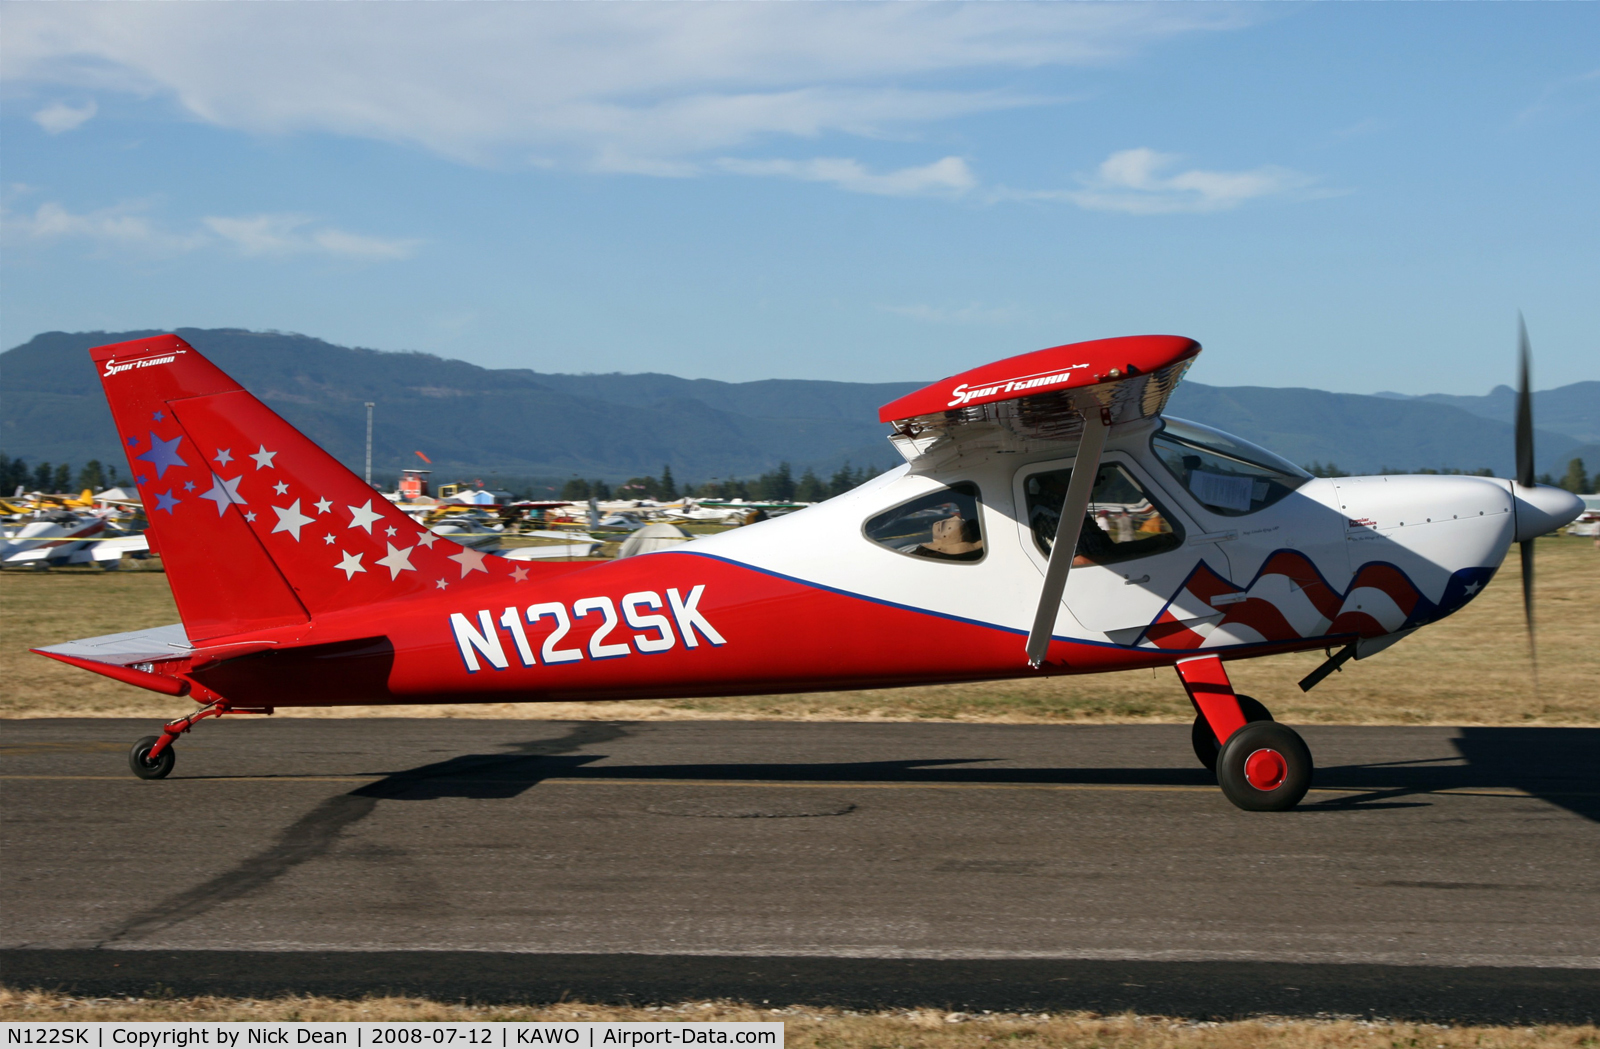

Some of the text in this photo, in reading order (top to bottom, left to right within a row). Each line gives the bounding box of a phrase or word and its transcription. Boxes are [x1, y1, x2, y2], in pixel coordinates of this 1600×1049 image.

[104, 356, 175, 377] Sportsman
[947, 372, 1071, 407] Sportsman
[449, 584, 727, 673] N122SK
